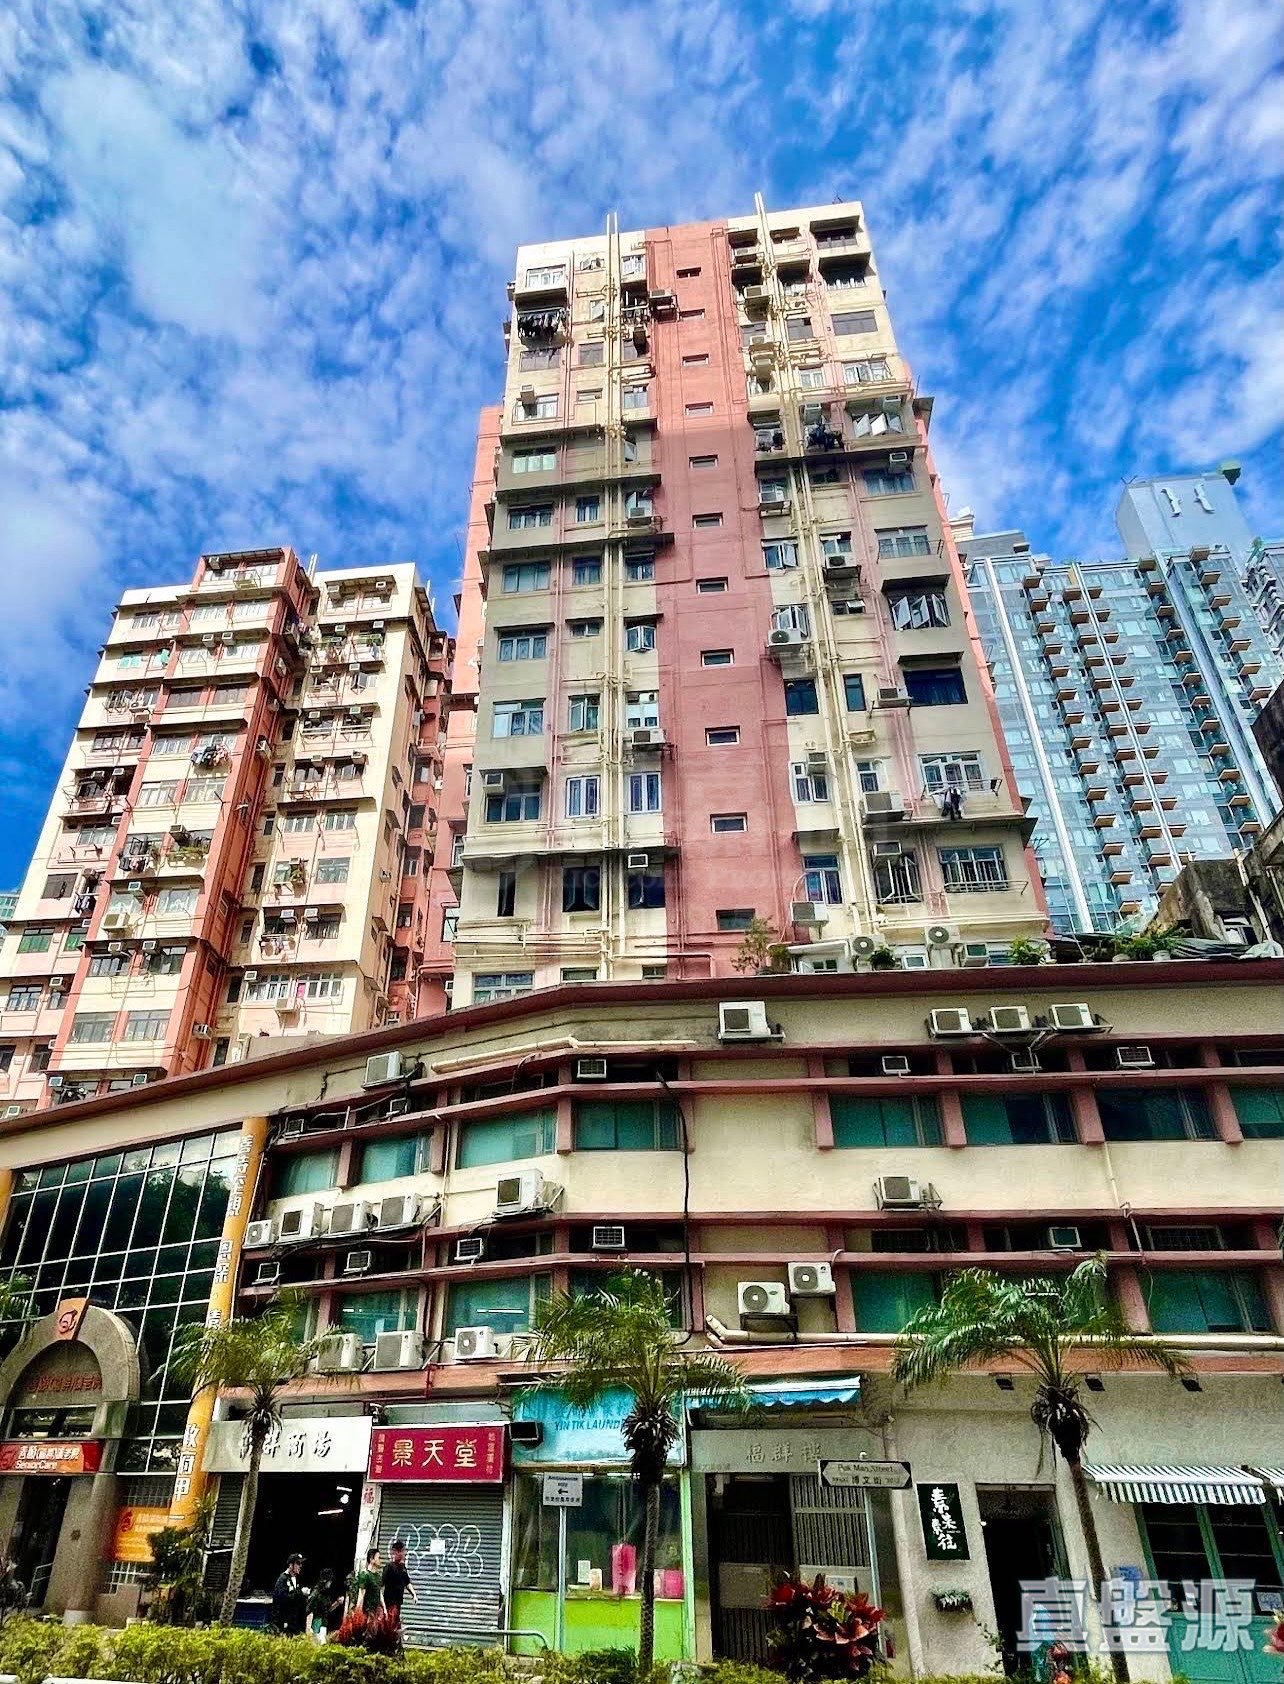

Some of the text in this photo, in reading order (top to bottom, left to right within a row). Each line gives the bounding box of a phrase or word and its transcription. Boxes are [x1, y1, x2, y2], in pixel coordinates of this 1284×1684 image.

[391, 1439, 478, 1468] 景天堂
[853, 1464, 869, 1472] Man
[870, 1464, 894, 1473] Street
